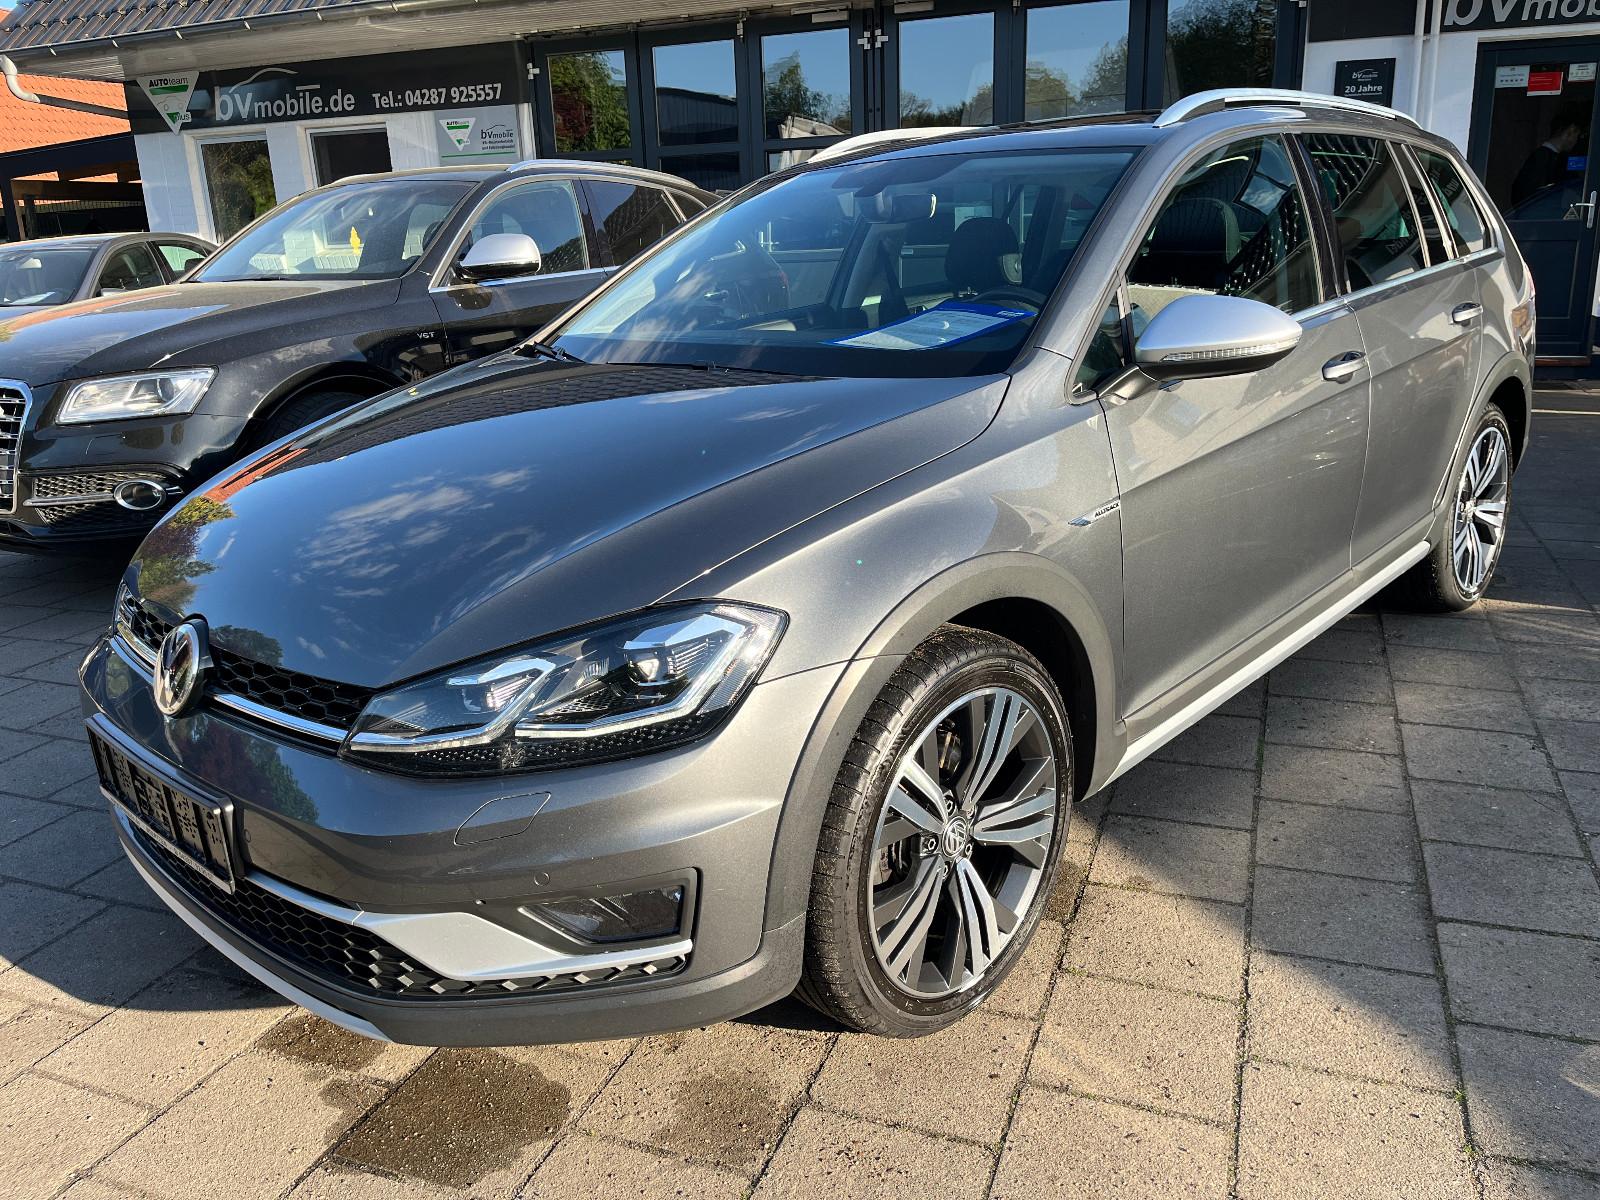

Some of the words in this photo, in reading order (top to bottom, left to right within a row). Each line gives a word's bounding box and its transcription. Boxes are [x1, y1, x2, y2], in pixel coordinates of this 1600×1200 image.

[372, 90, 403, 109] Tel.:
[405, 87, 447, 106] 04287
[450, 82, 502, 103] 925557
[1344, 85, 1356, 93] 20
[1357, 84, 1383, 93] Jahre
[214, 85, 356, 121] bvmobile.de
[480, 129, 514, 140] bvmobile
